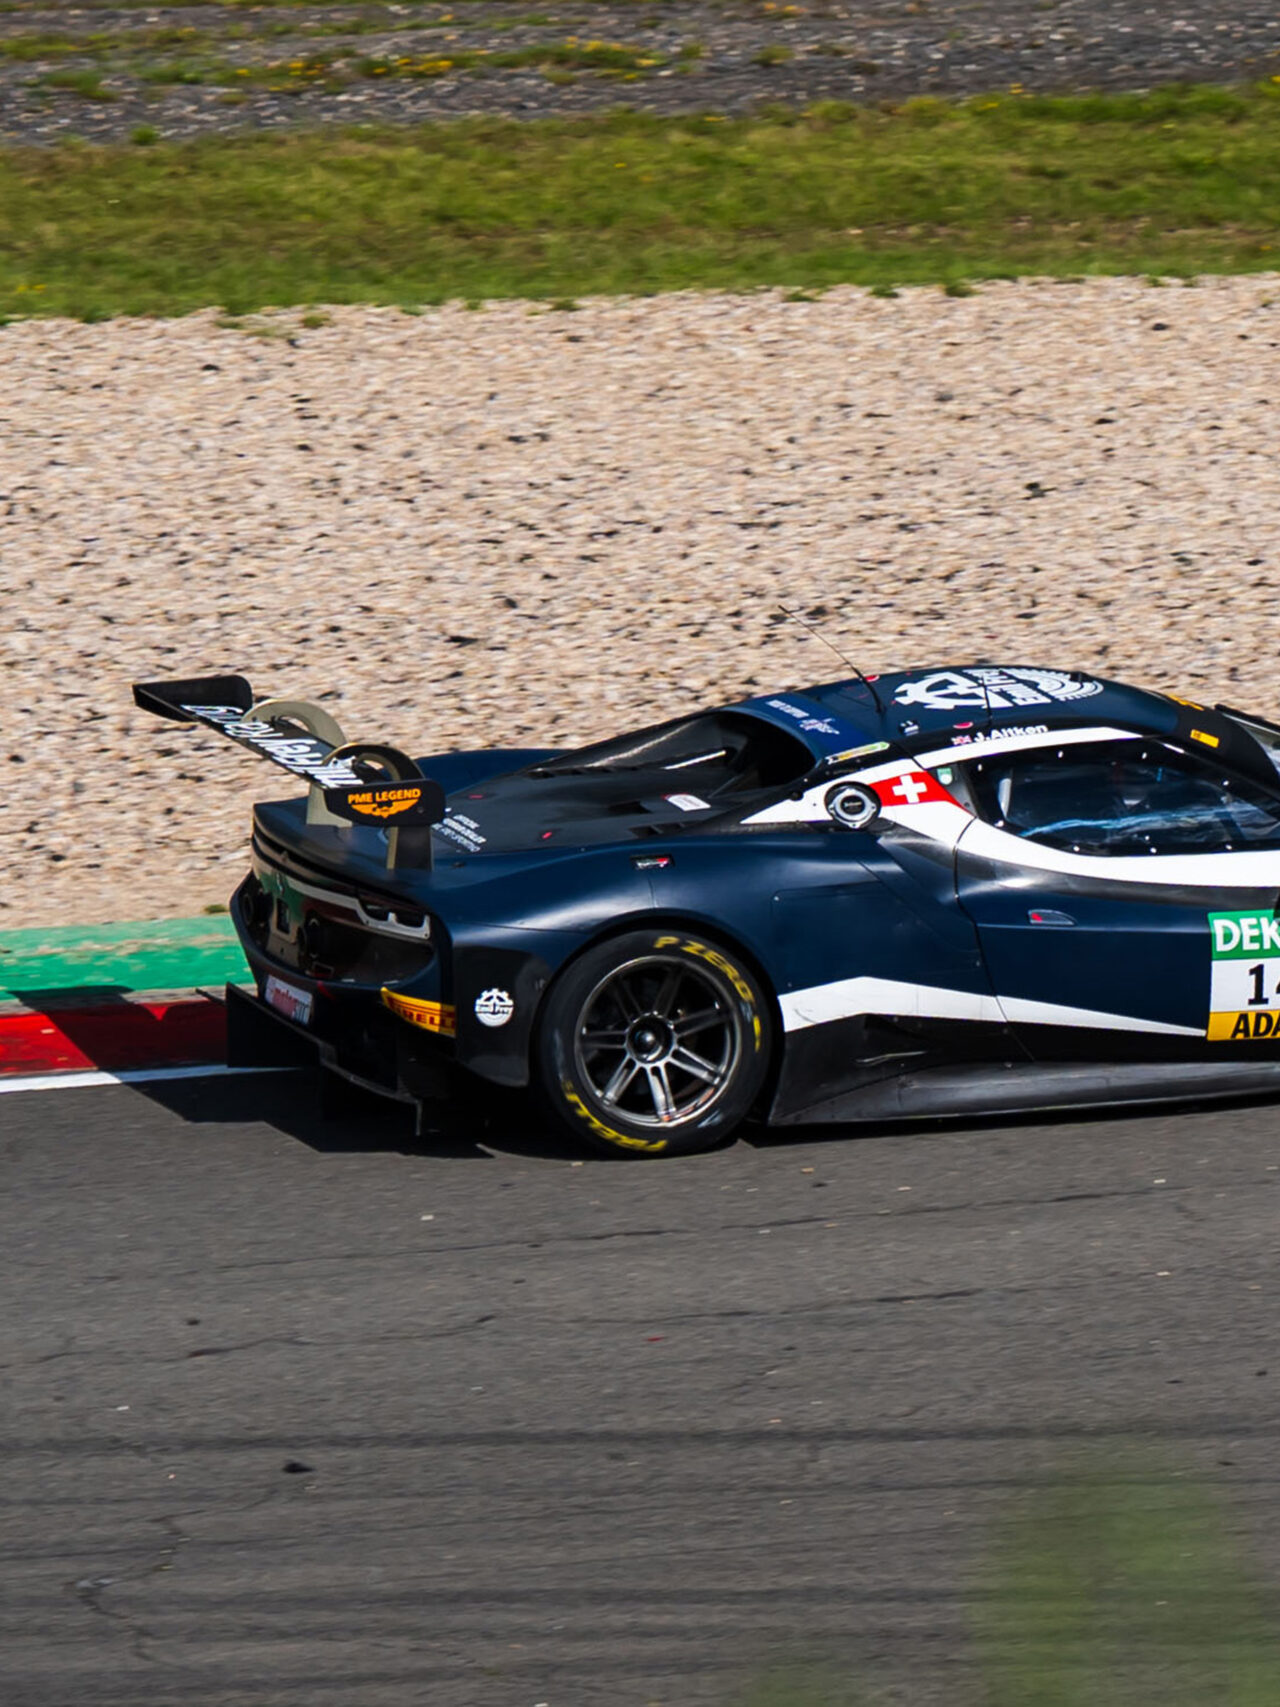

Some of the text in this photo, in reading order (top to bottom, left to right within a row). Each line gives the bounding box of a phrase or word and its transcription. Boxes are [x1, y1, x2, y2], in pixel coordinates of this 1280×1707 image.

[974, 724, 1048, 743] J.Aitken
[347, 788, 422, 804] PME LEGEND
[680, 940, 756, 1008] ZERO
